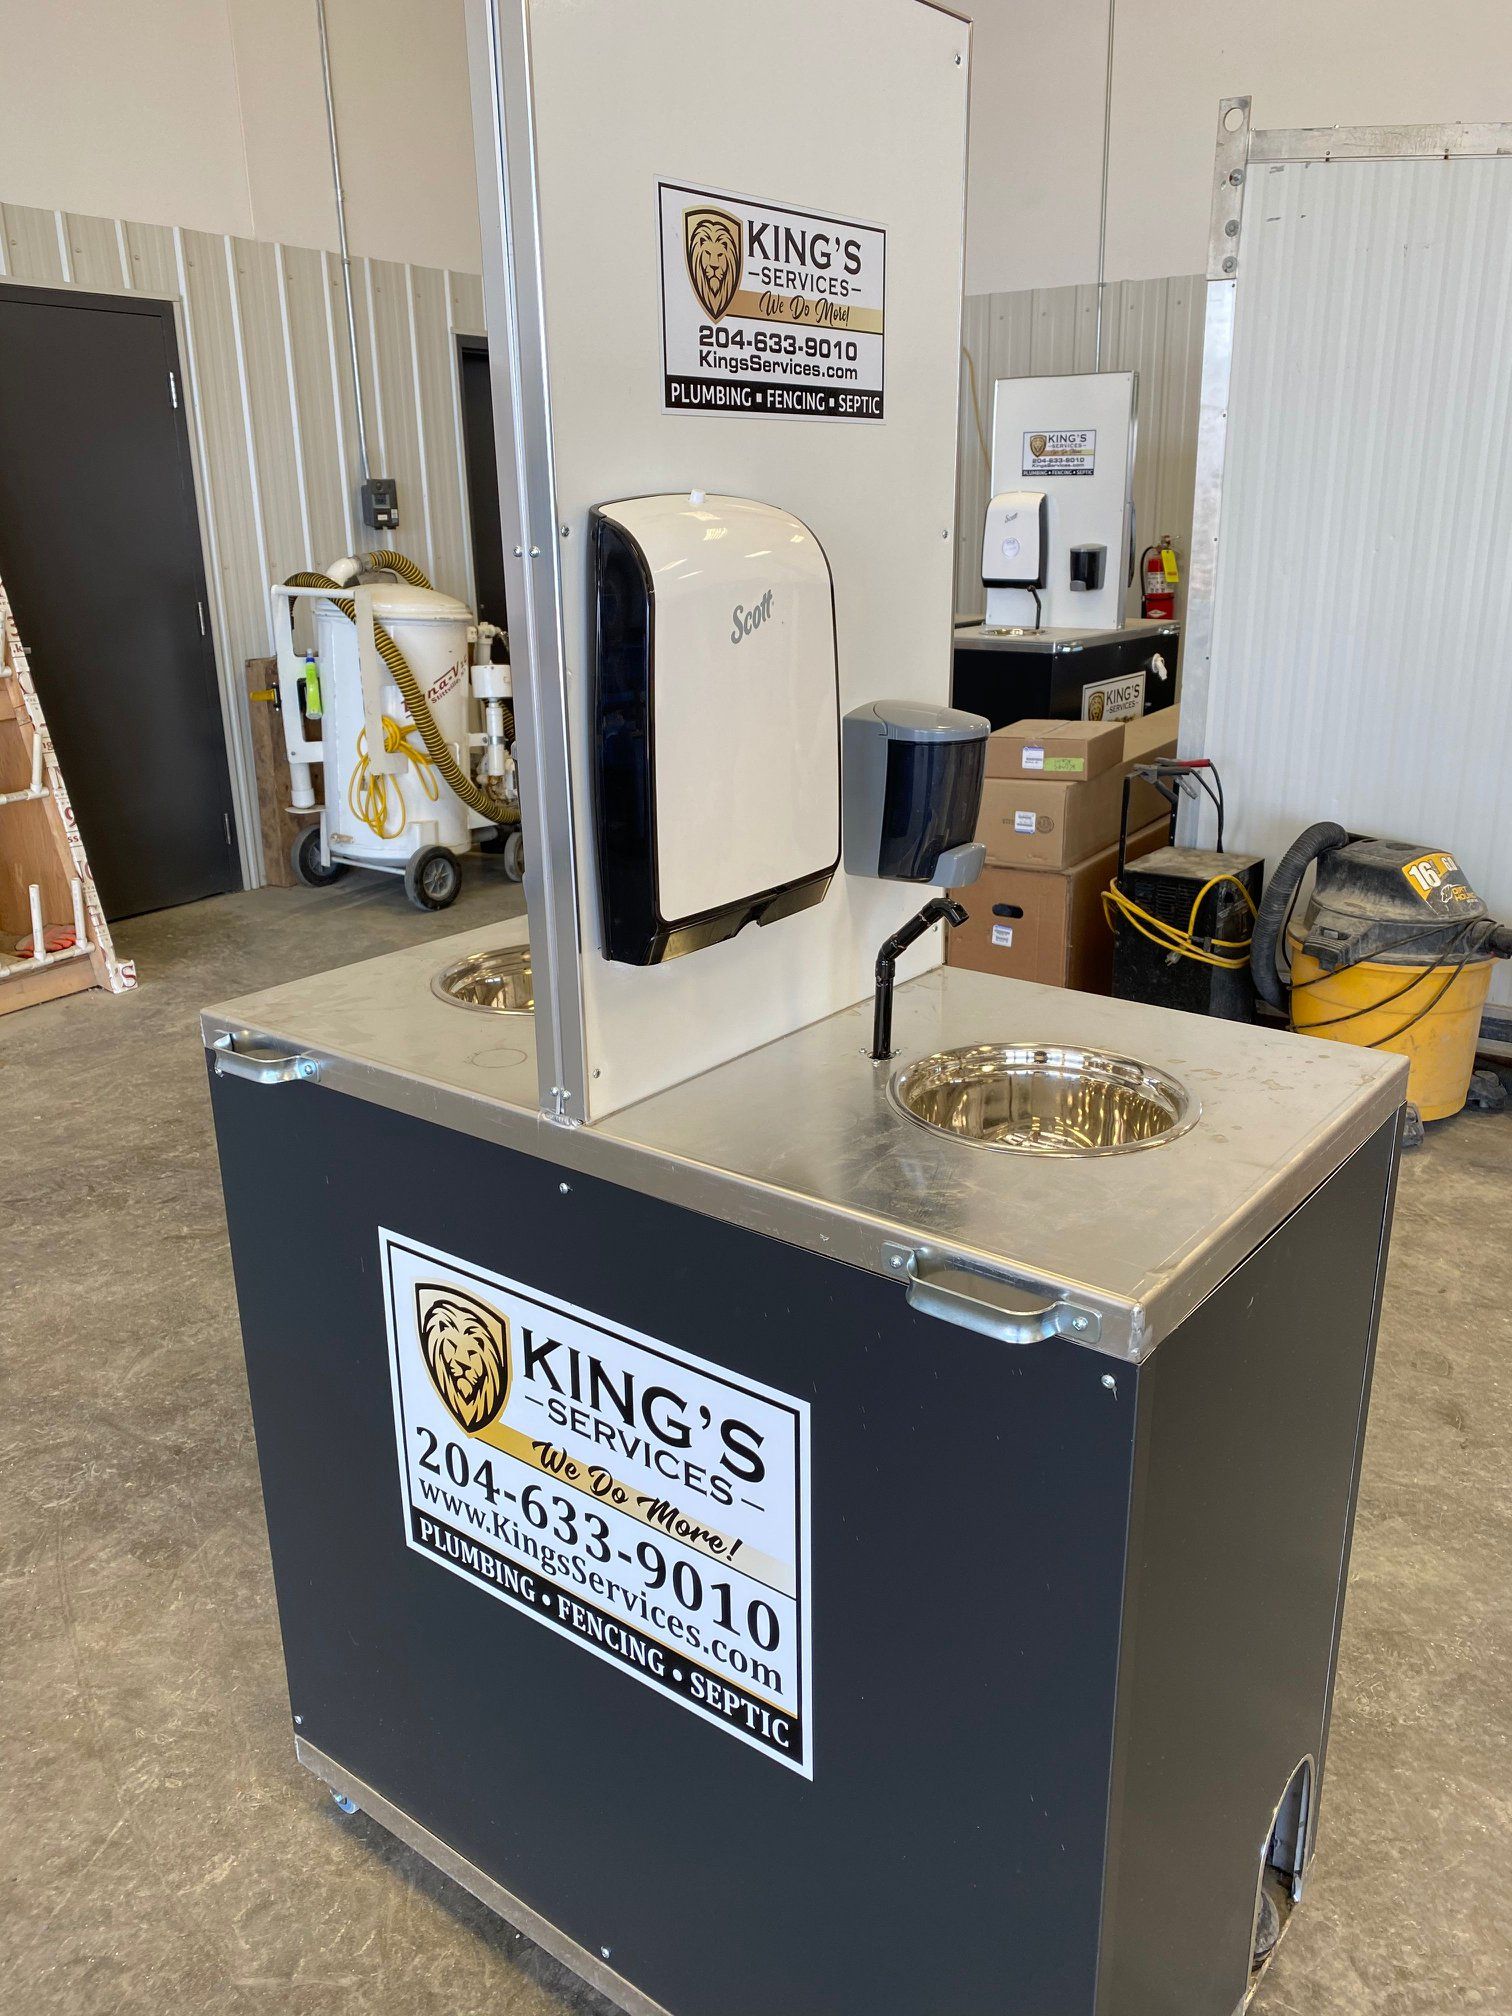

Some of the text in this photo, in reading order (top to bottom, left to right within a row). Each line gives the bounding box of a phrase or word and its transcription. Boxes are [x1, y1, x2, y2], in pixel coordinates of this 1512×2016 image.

[747, 219, 862, 275] KING'S
[761, 266, 849, 297] SERVICES
[759, 290, 850, 327] We Do More!
[699, 325, 858, 361] 204-633-9010
[699, 349, 858, 380] KingsServices.com
[671, 382, 880, 414] PLUMBING FENCING SEPTIC
[1048, 433, 1087, 443] KING'S
[730, 589, 773, 644] Scott
[1106, 684, 1140, 705] KING'S
[1408, 861, 1441, 891] 16
[521, 1325, 766, 1484] KING'S
[548, 1399, 734, 1506] SERVICES
[532, 1439, 743, 1562] We Do More!
[416, 1425, 781, 1653] 204-633-9010
[419, 1477, 784, 1697] www.KingsServices.com
[419, 1517, 790, 1749] PLUMBING FENCING SEPTIC
